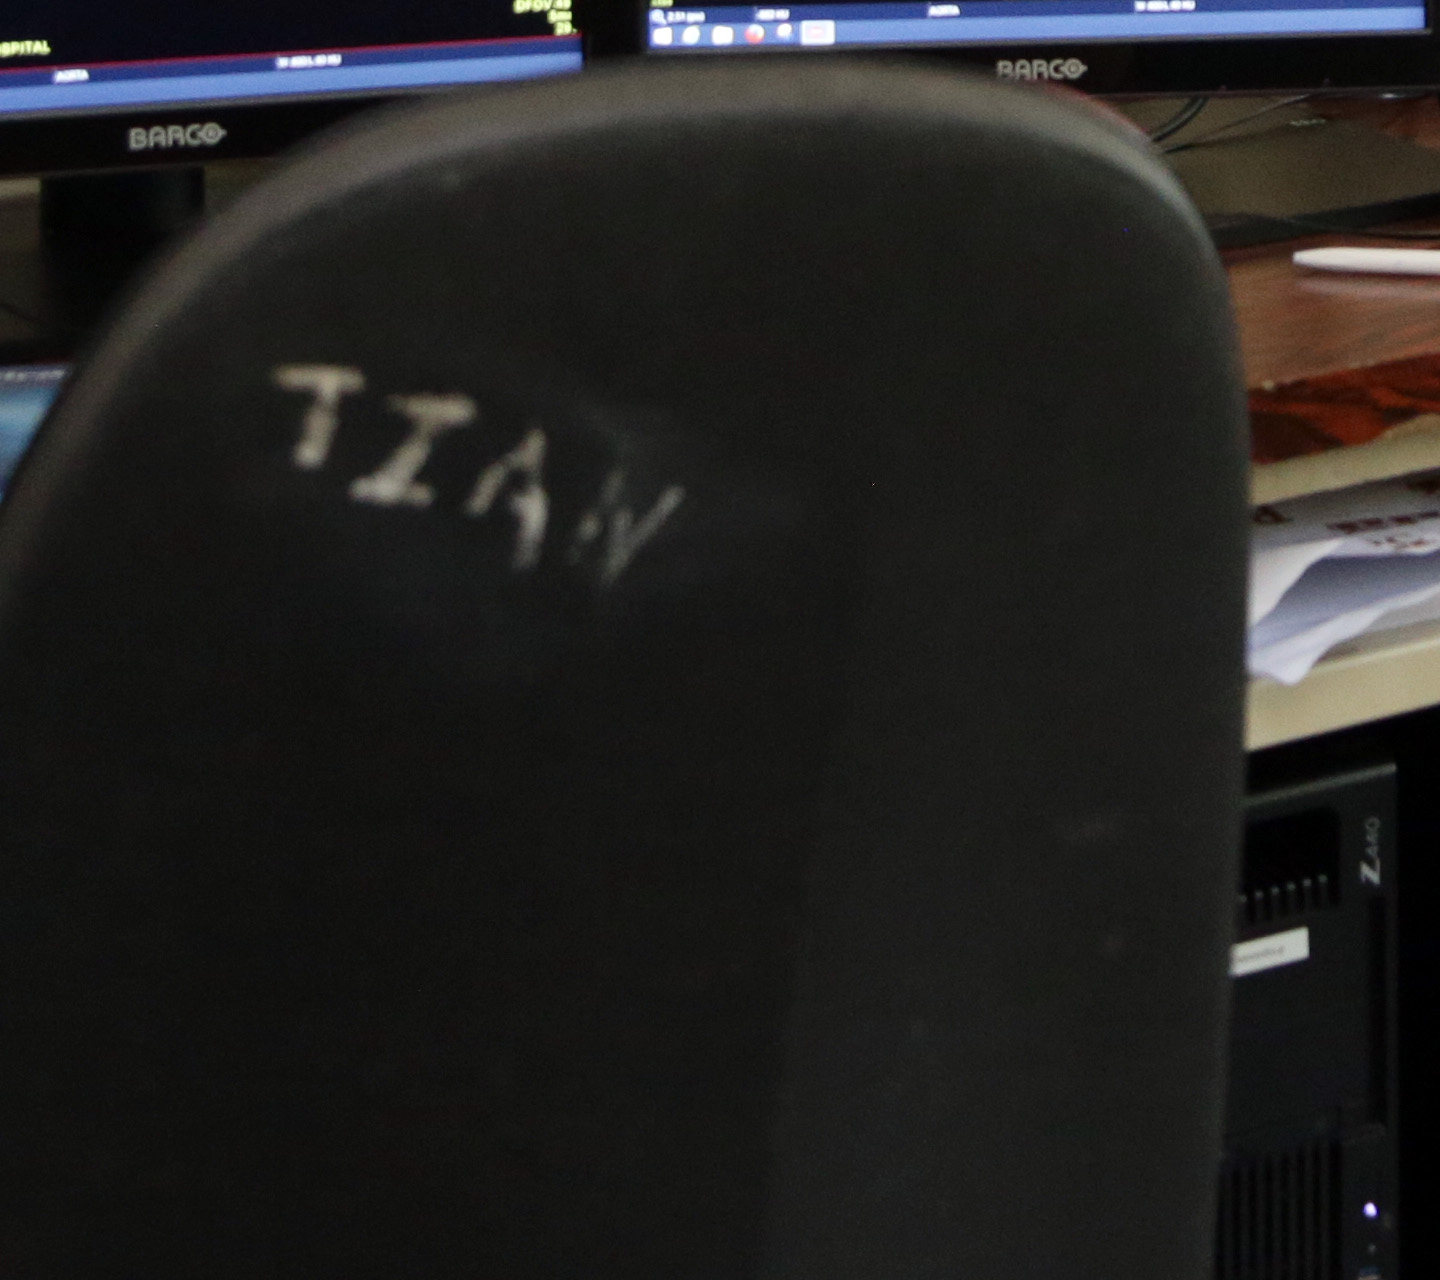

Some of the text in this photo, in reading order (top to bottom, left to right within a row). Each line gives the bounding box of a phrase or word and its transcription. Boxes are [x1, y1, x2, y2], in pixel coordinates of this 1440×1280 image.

[997, 56, 1088, 80] BARCO
[128, 122, 227, 151] BARCO
[1359, 815, 1380, 885] Z440
